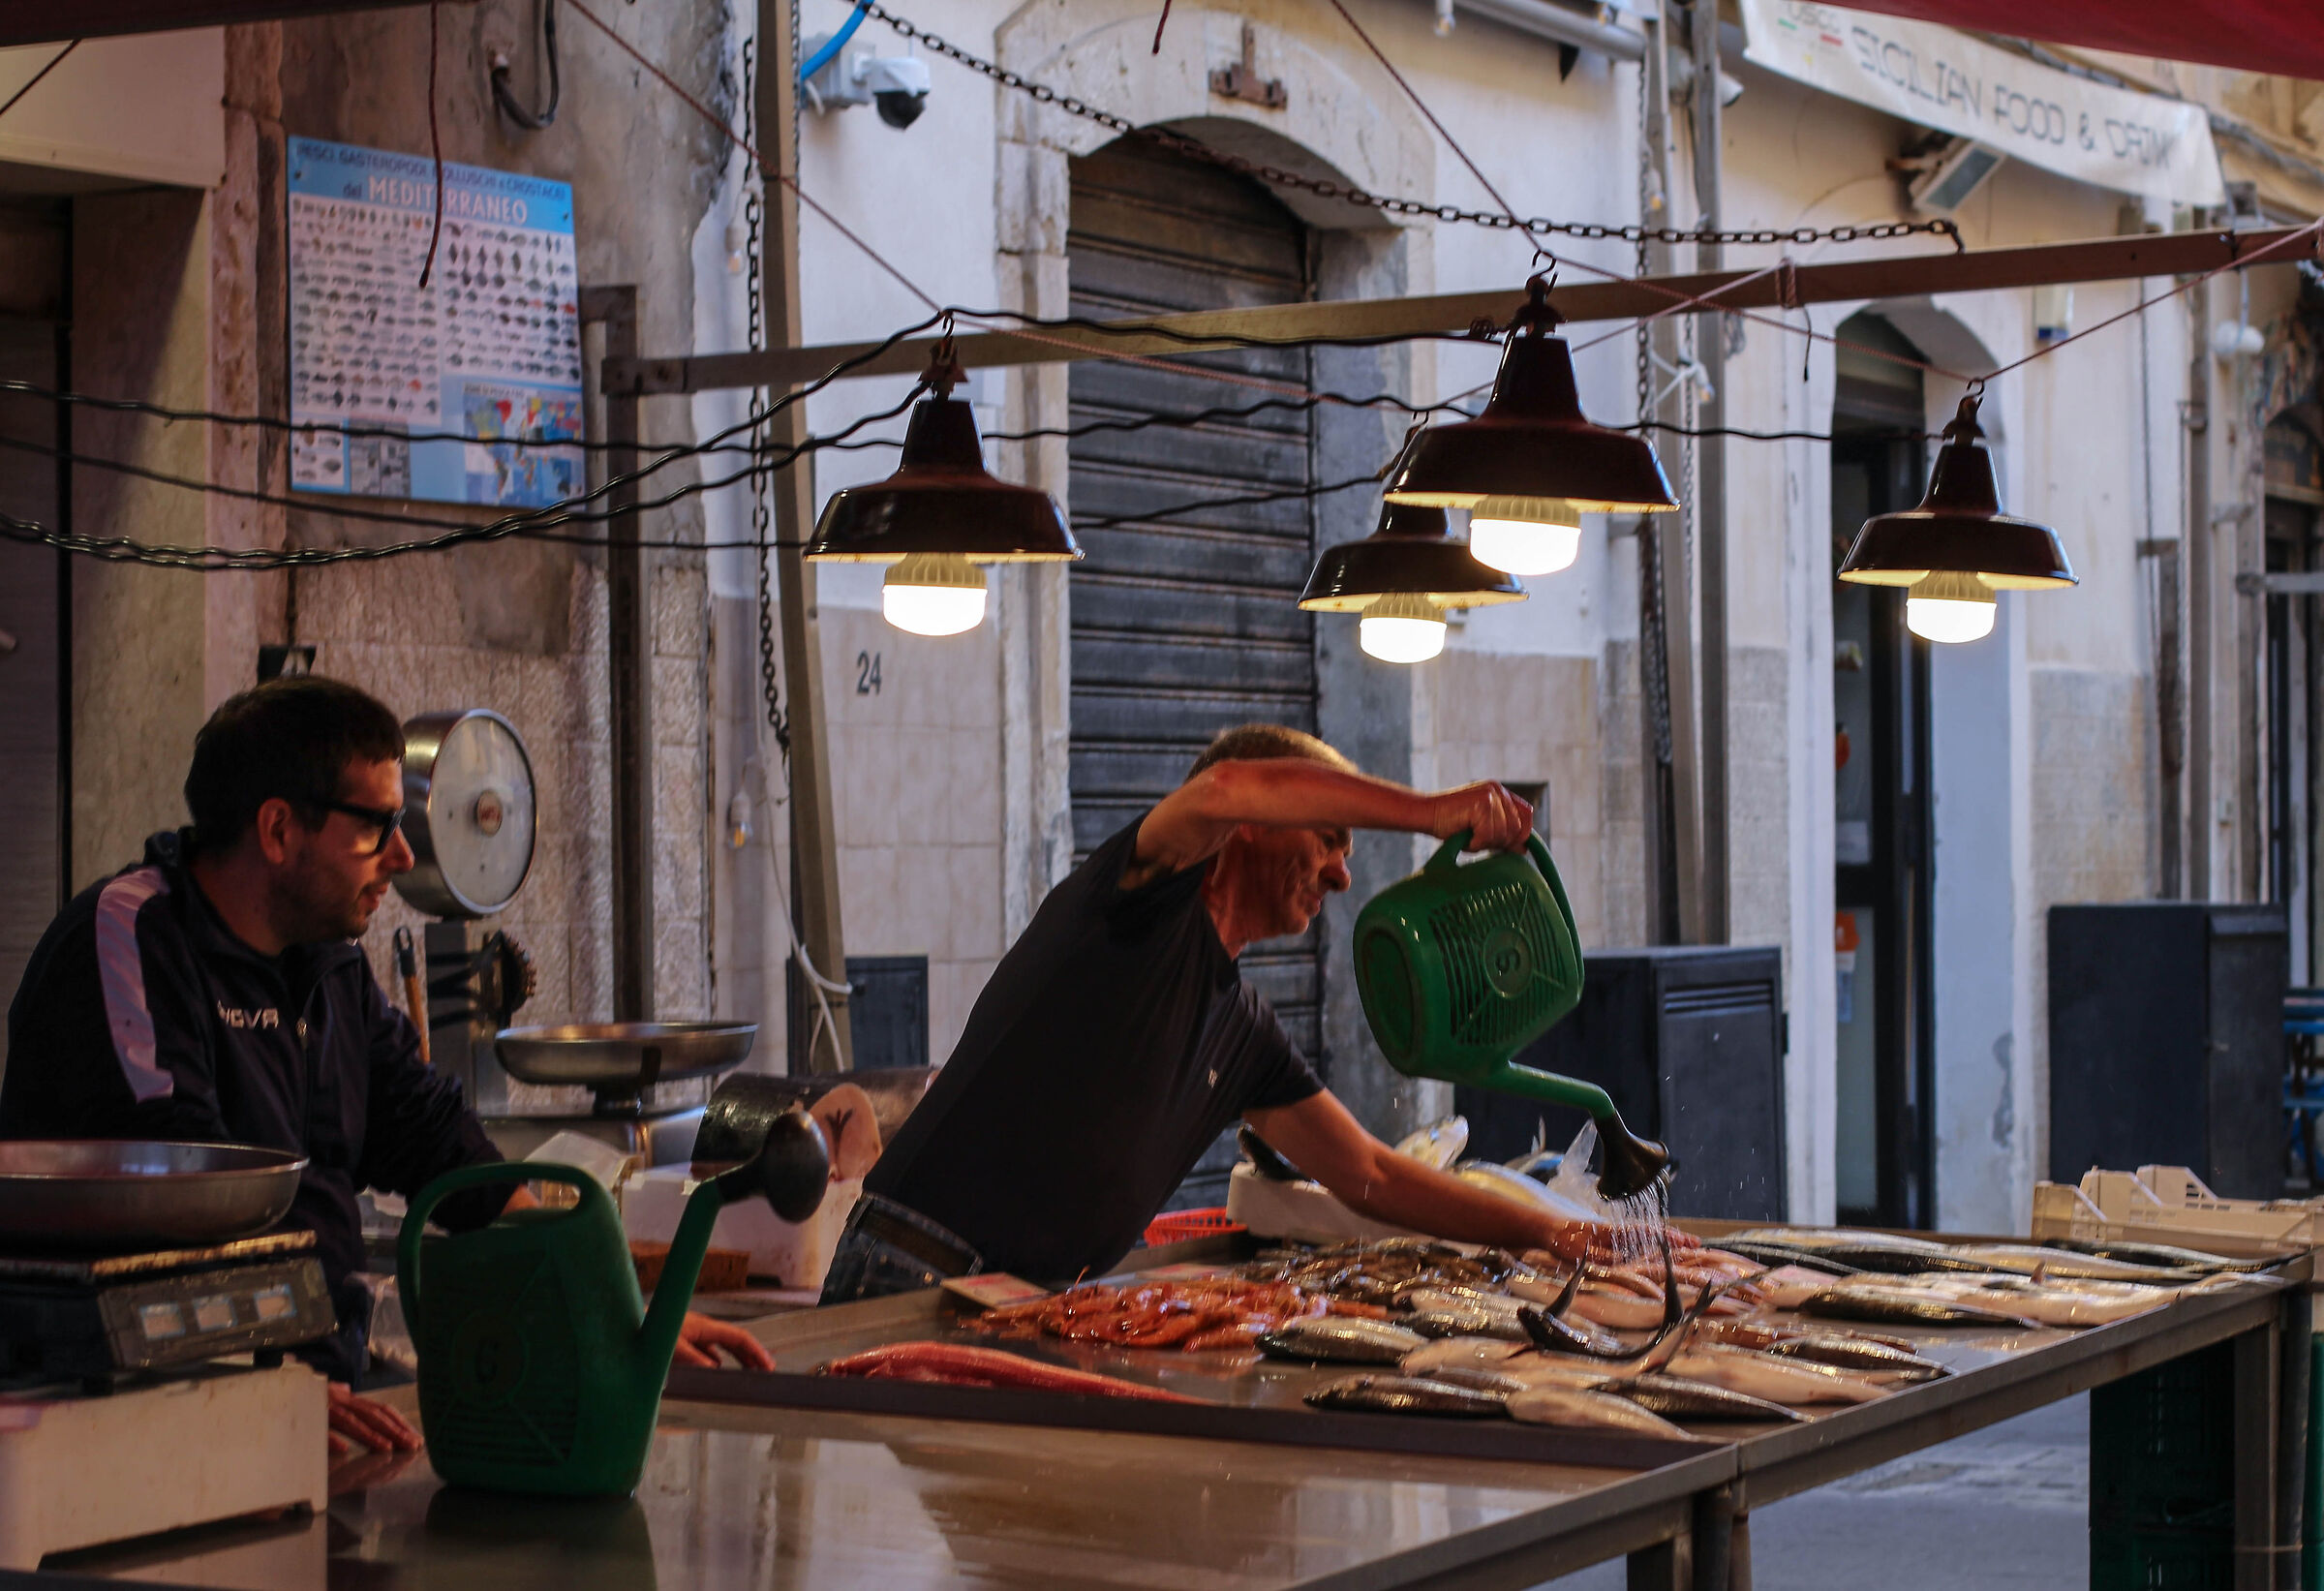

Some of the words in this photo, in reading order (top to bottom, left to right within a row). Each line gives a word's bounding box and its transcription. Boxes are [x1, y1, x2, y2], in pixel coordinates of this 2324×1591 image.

[1851, 25, 1981, 118] SICILIAN
[1994, 83, 2065, 145] FOOD
[2079, 111, 2097, 152] &
[856, 650, 882, 696] 24
